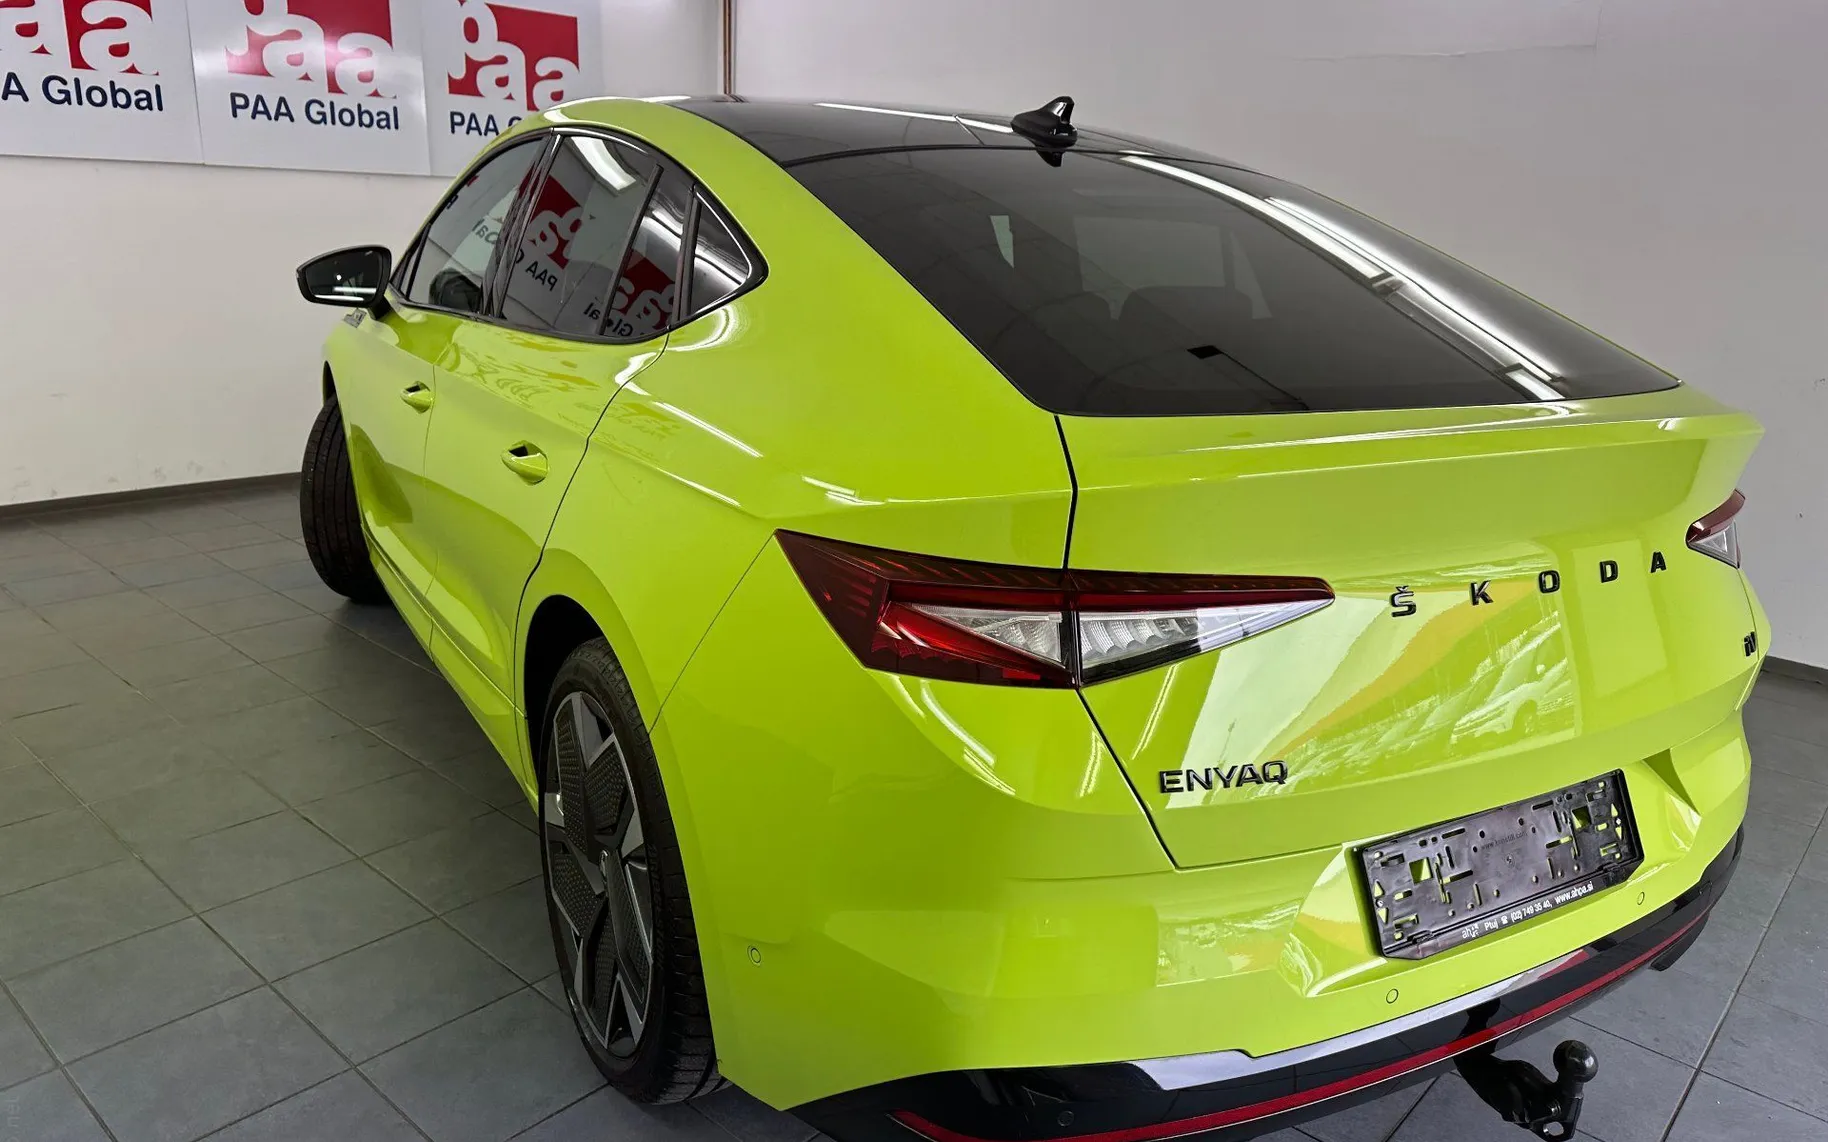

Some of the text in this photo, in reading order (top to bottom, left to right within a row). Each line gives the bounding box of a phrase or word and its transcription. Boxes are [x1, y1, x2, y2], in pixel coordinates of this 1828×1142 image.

[41, 75, 164, 112] Global
[230, 92, 400, 131] PAA Global
[450, 111, 500, 137] PAA
[1389, 551, 1668, 618] ŠKODA
[1159, 760, 1288, 794] ENYAQ
[1484, 919, 1499, 932] Ptuj
[1511, 911, 1523, 922] (02)
